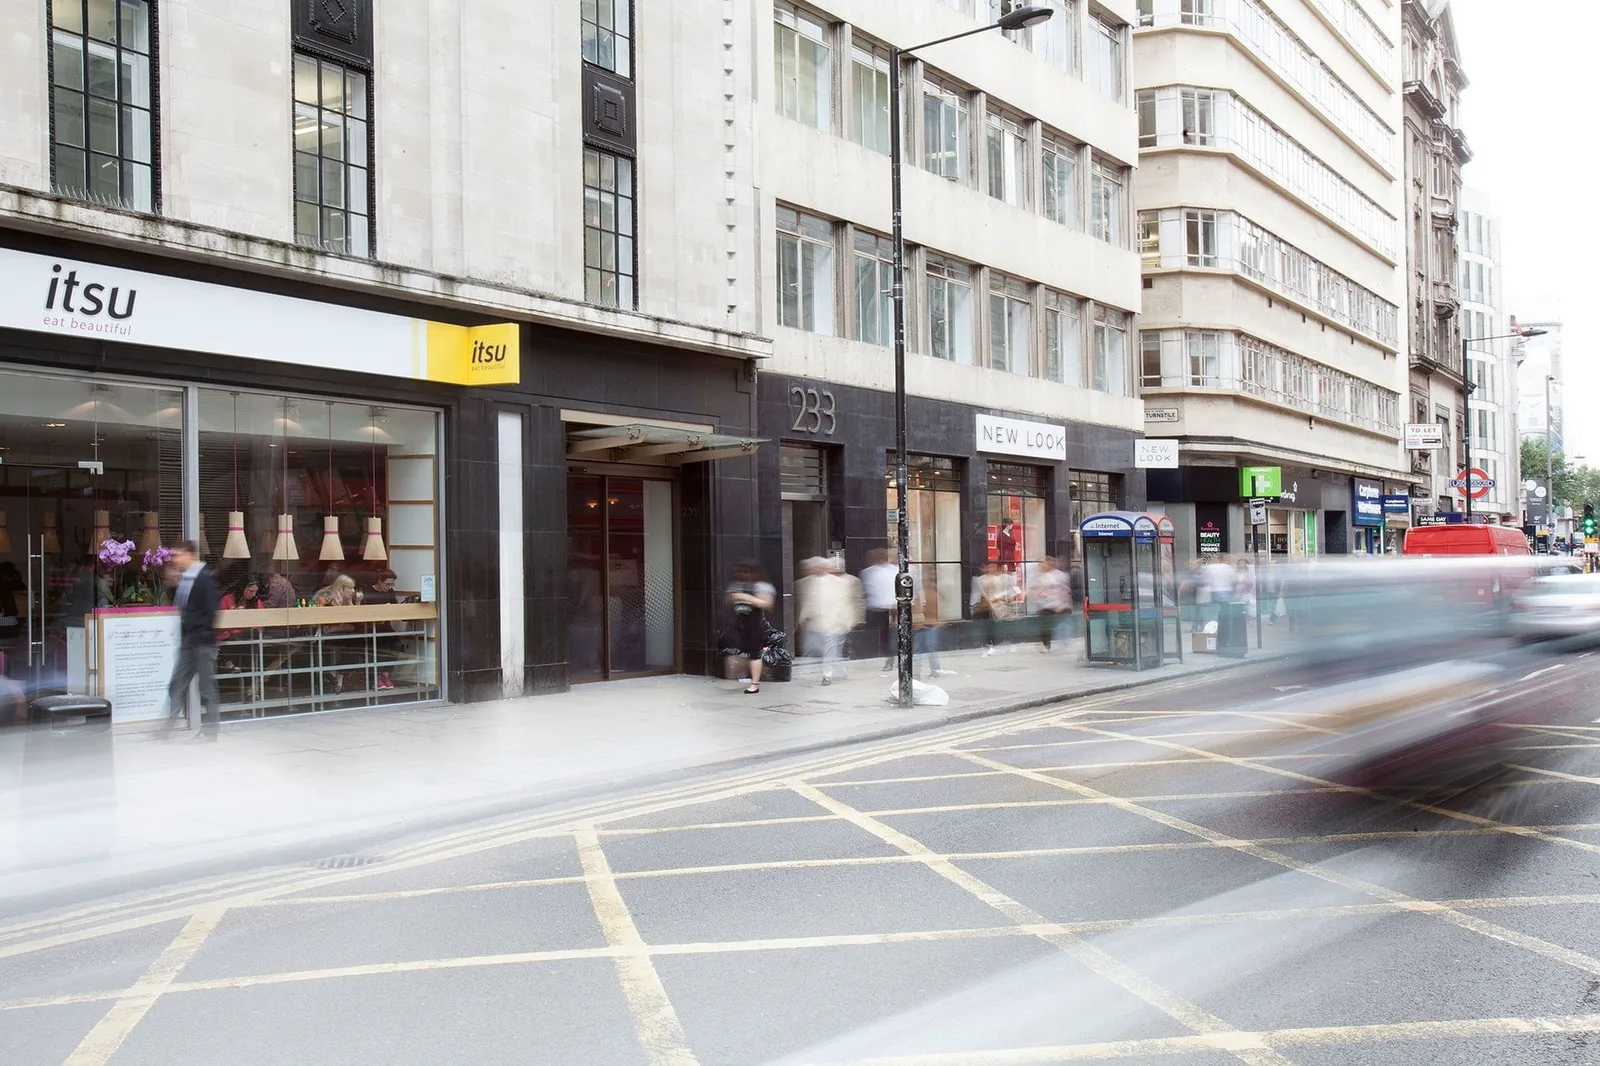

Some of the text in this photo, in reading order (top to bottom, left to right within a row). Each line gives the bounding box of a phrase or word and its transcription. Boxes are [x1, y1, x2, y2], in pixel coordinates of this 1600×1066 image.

[45, 263, 137, 320] itsu
[43, 316, 131, 336] eat beautiful
[471, 339, 507, 364] itsu
[790, 386, 836, 435] 233
[983, 425, 1065, 450] NEW LOOK
[1141, 445, 1169, 453] NEW
[1139, 454, 1171, 462] LOOK
